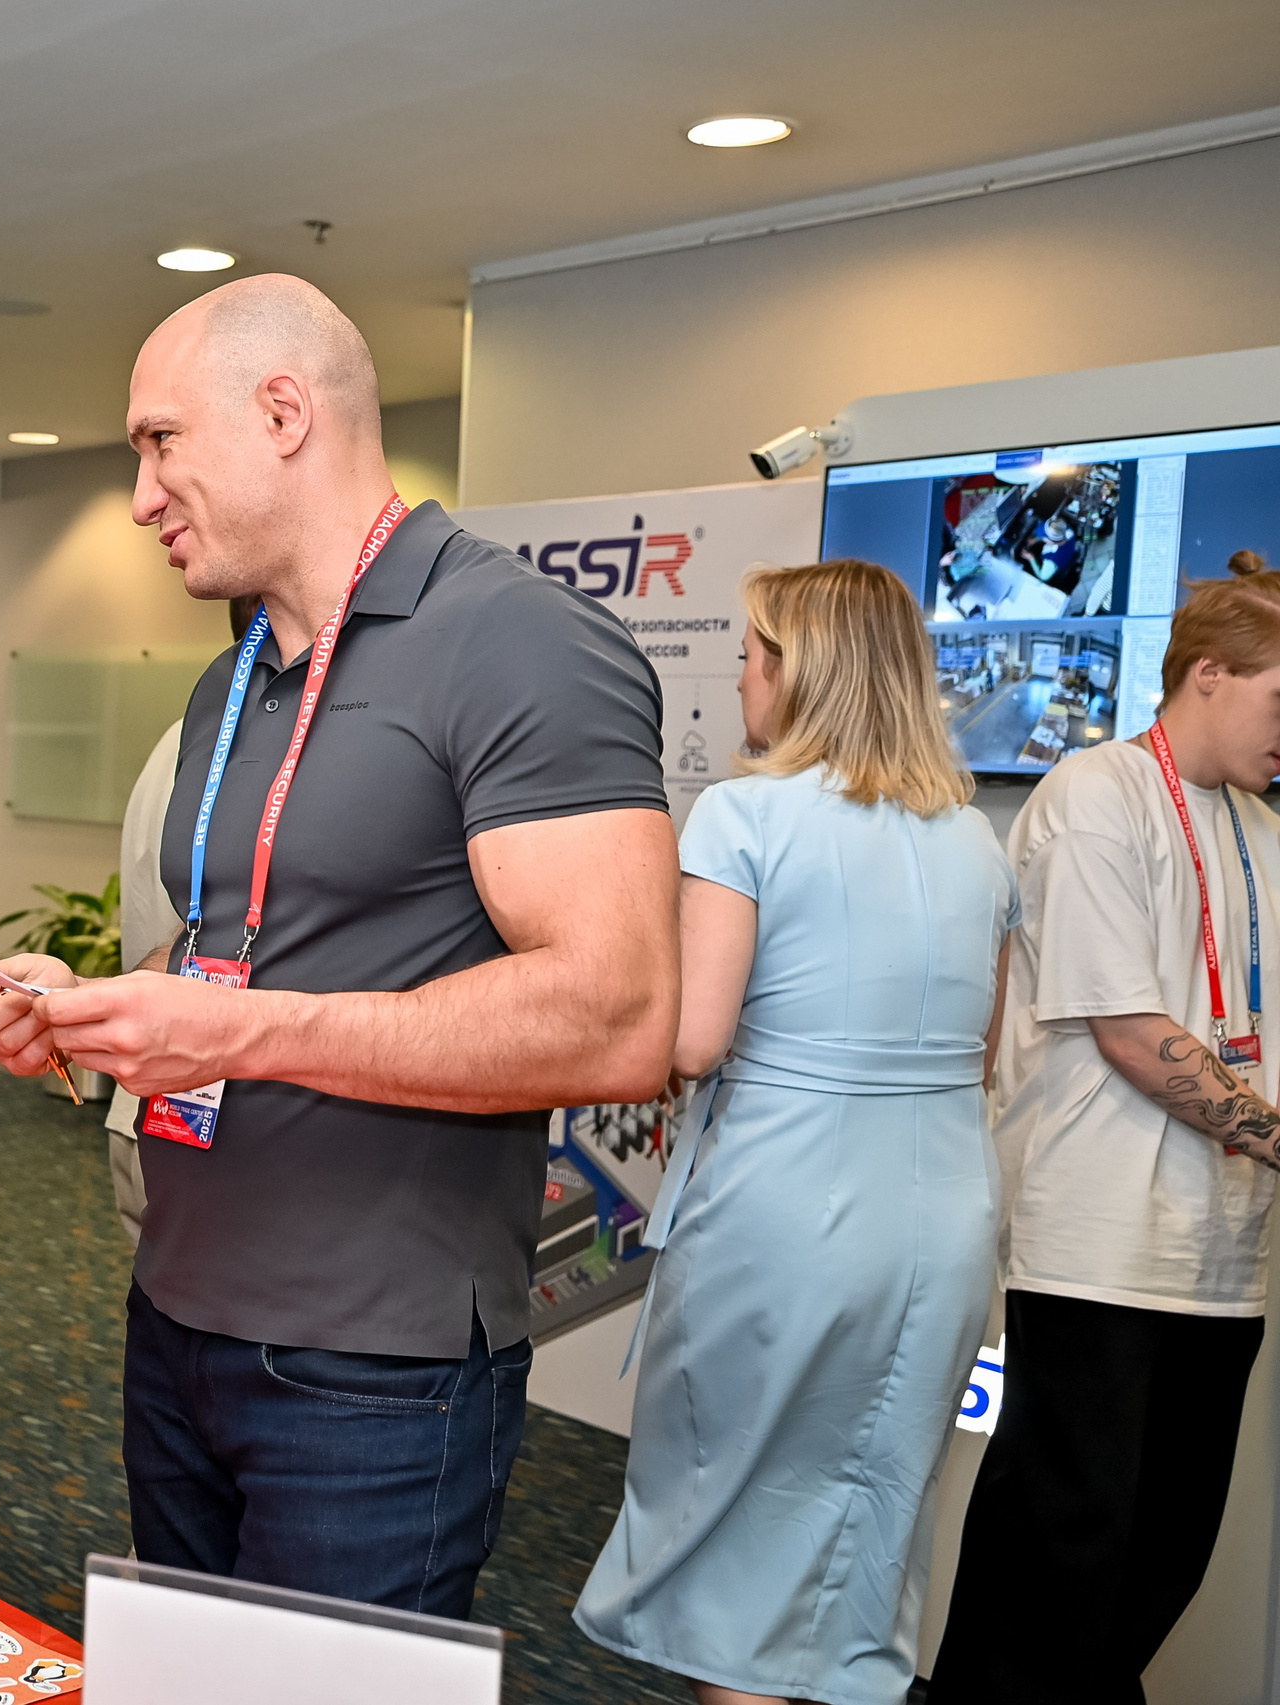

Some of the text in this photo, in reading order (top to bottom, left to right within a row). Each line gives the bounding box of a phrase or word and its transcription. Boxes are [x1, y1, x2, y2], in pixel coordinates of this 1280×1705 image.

[517, 513, 693, 599] SSIR
[234, 610, 269, 691] АССОЦИА
[195, 703, 239, 847] RETAIL SECURITY
[262, 691, 317, 848] RETAIL SECURITY
[1203, 912, 1217, 971] SECURITY
[198, 1110, 213, 1143] 2025
